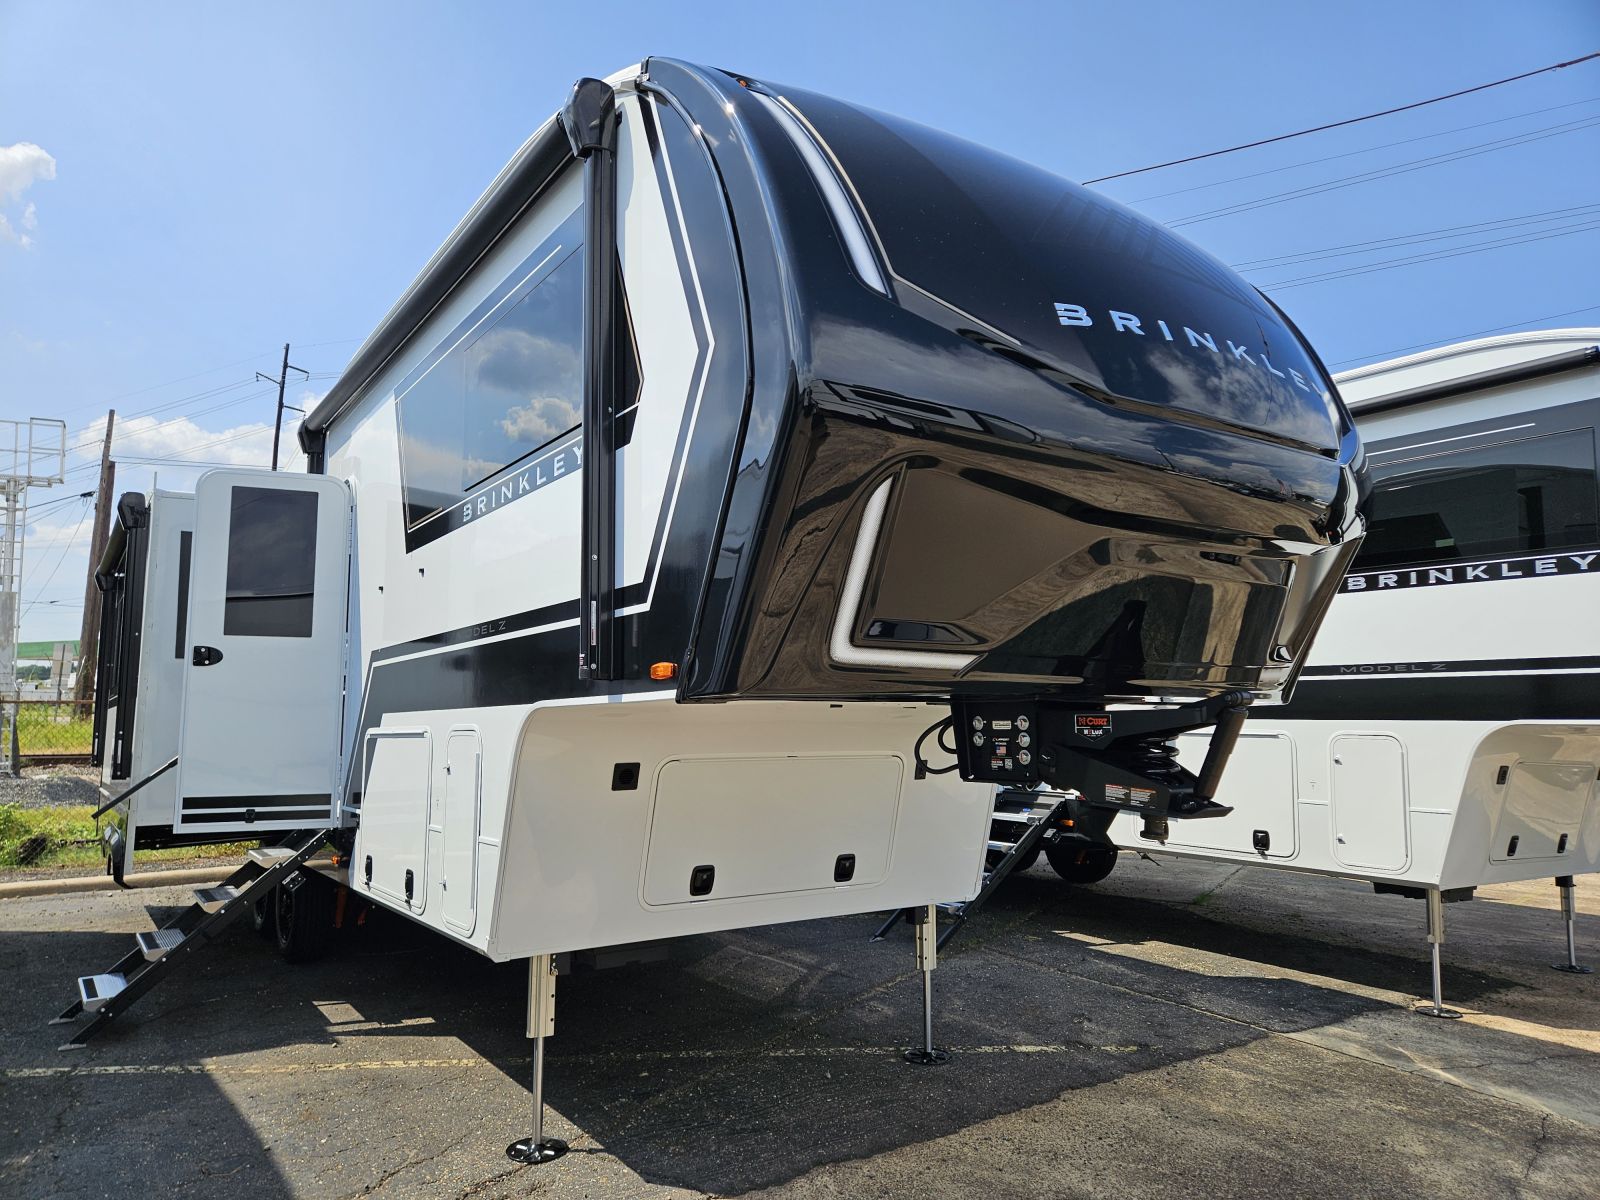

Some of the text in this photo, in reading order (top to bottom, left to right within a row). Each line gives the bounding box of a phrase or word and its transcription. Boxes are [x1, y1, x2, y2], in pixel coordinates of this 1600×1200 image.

[1053, 302, 1321, 394] BRINKLE
[463, 443, 583, 522] BRINKLEY
[1347, 554, 1598, 591] BRINKLEY
[498, 620, 506, 631] Z
[1340, 663, 1448, 673] MODEL Z
